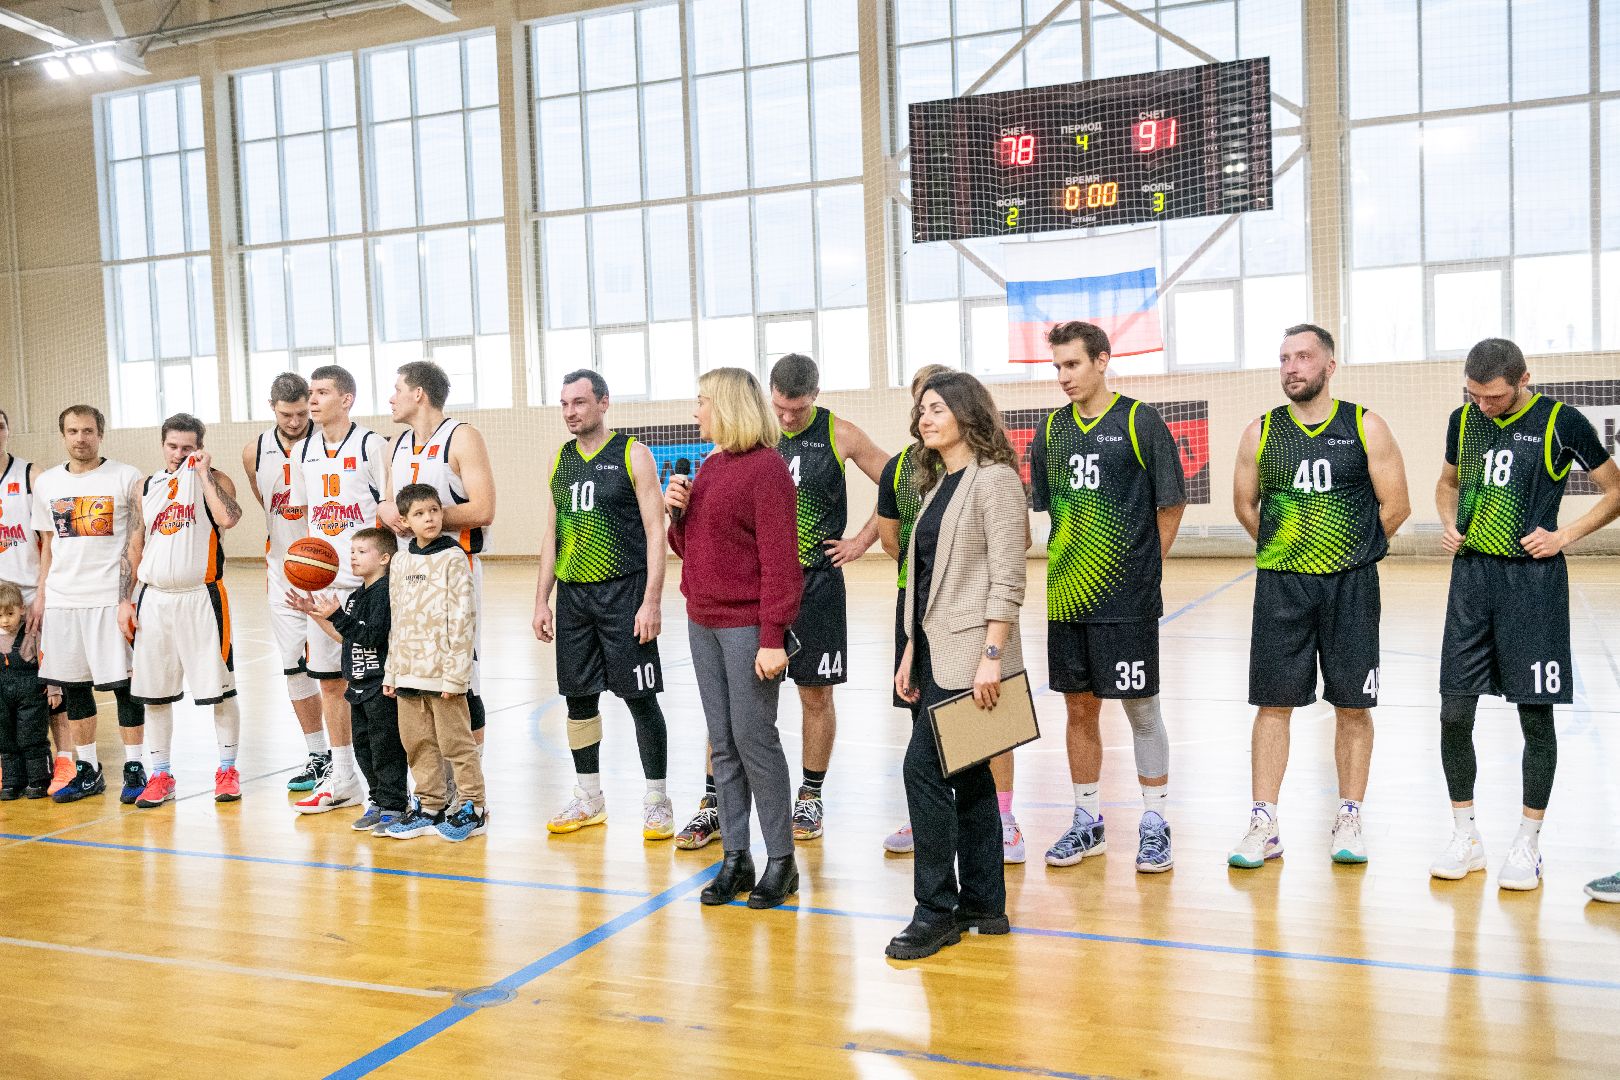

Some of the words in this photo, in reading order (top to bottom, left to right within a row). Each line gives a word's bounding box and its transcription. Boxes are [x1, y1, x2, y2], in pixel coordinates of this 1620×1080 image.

[1139, 110, 1166, 121] СЧЕТ
[1061, 122, 1103, 135] ПЕРИОД
[1139, 120, 1176, 151] 91
[1002, 135, 1034, 165] 78
[1076, 134, 1088, 151] 4
[1065, 174, 1100, 186] ВРЕМЯ
[1141, 182, 1175, 193] ФОЛЫ
[996, 198, 1027, 207] ФОЛЫ
[1153, 192, 1164, 212] 3
[1007, 207, 1018, 226] 2
[411, 463, 420, 485] 7
[1069, 453, 1100, 490] 35
[1293, 459, 1332, 493] 40
[1483, 449, 1514, 486] 18
[167, 476, 179, 500] 3
[569, 480, 595, 512] 10
[363, 647, 380, 670] GIVE
[817, 650, 843, 679] 44
[632, 662, 656, 691] 10
[1115, 660, 1146, 691] 35
[1530, 660, 1561, 694] 18
